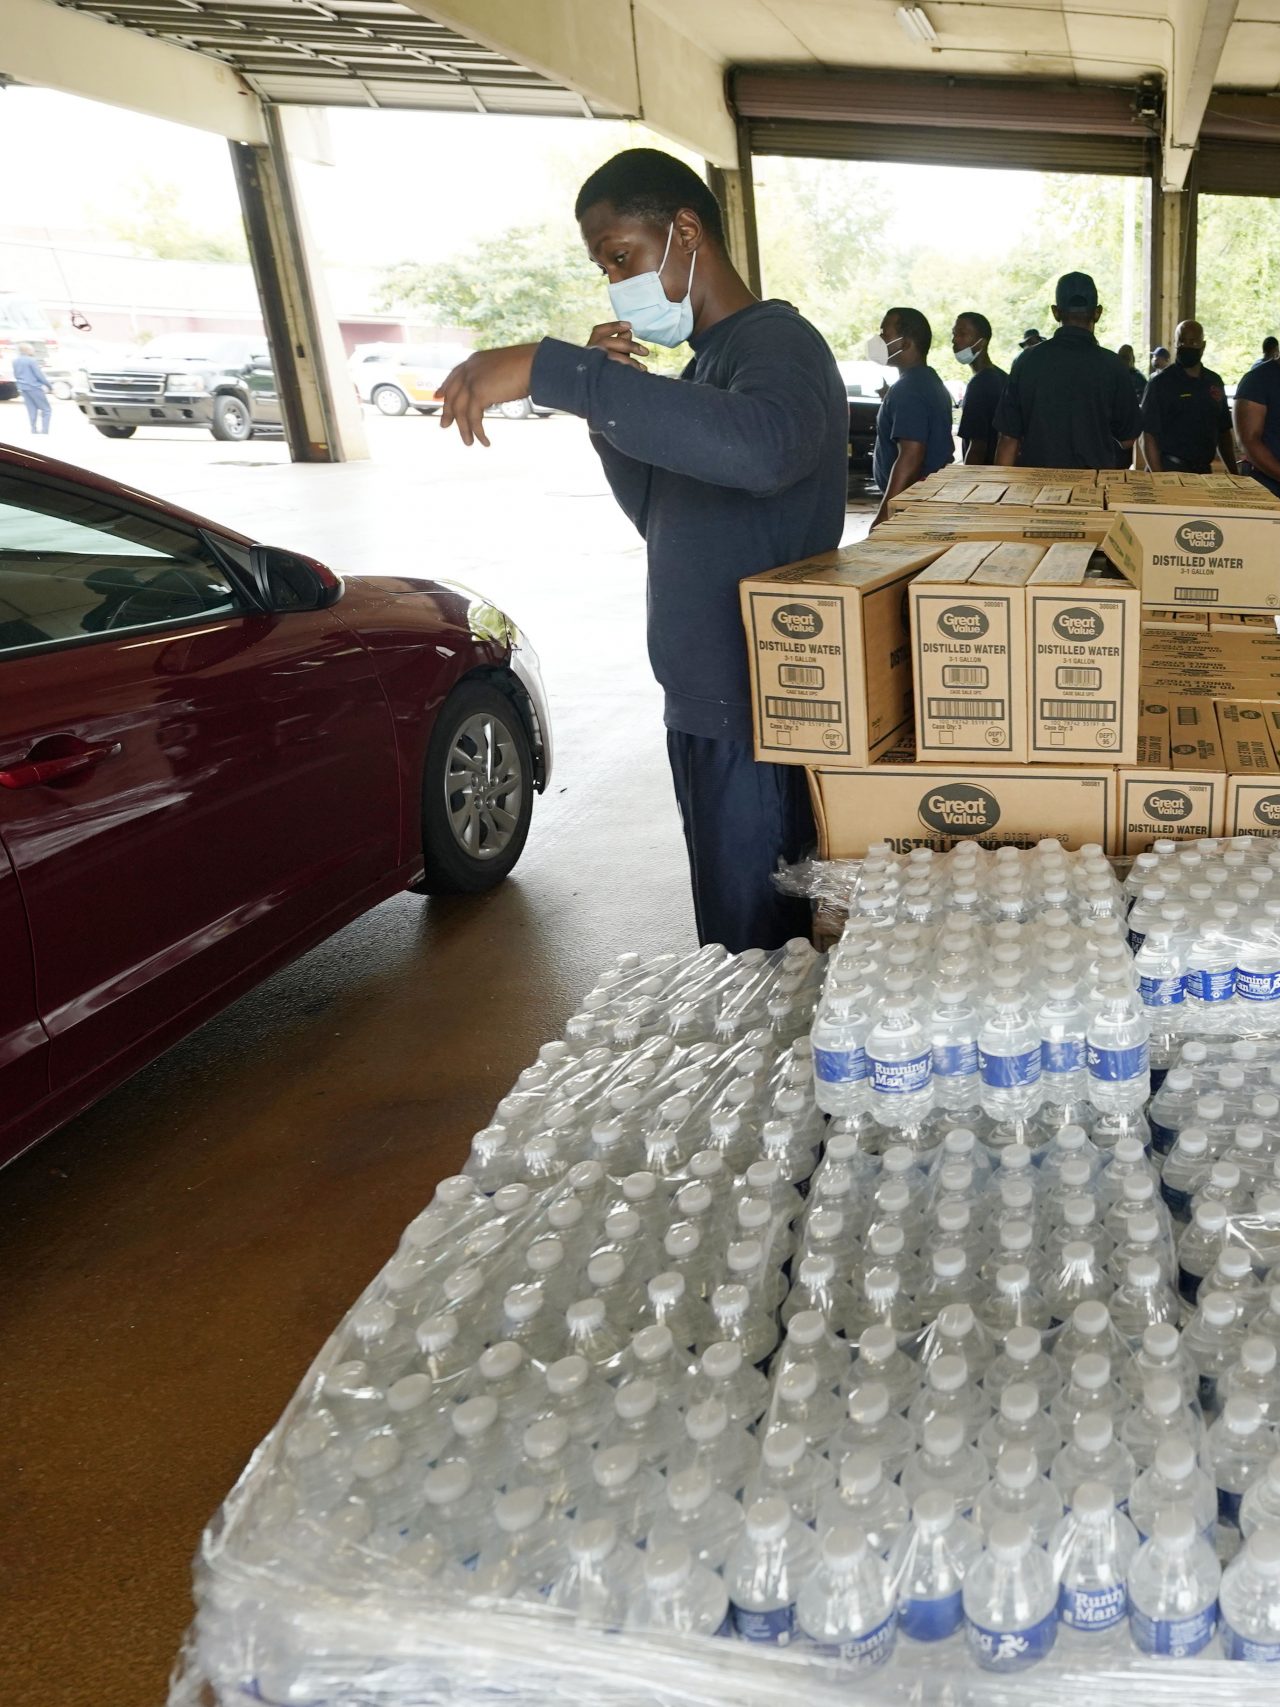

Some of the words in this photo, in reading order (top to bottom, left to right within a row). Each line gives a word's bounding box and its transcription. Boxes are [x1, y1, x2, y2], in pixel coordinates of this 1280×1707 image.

[1181, 528, 1215, 540] Great
[1189, 539, 1215, 548] Value
[1152, 555, 1206, 568] DISTILLED
[1208, 558, 1244, 568] WATER
[778, 611, 814, 626] Great
[943, 613, 980, 626] Great
[1058, 615, 1096, 628] Great
[786, 624, 815, 633] Value
[952, 624, 980, 633] Value
[1068, 626, 1096, 635] Value
[759, 640, 806, 654] DISTILLED
[808, 644, 841, 656] WATER
[923, 643, 971, 654] DISTILLED
[974, 644, 1006, 654] WATER
[1038, 644, 1085, 656] DISTILLED
[1088, 646, 1120, 656] WATER
[928, 795, 986, 814] Great
[1150, 796, 1184, 809] Great
[1158, 806, 1184, 816] Value
[943, 812, 986, 825] Value
[1128, 824, 1174, 834] DISTILLED
[1177, 826, 1207, 835] WATER
[875, 1060, 927, 1076] Running
[875, 1072, 904, 1087] Man
[1074, 1604, 1116, 1622] Man
